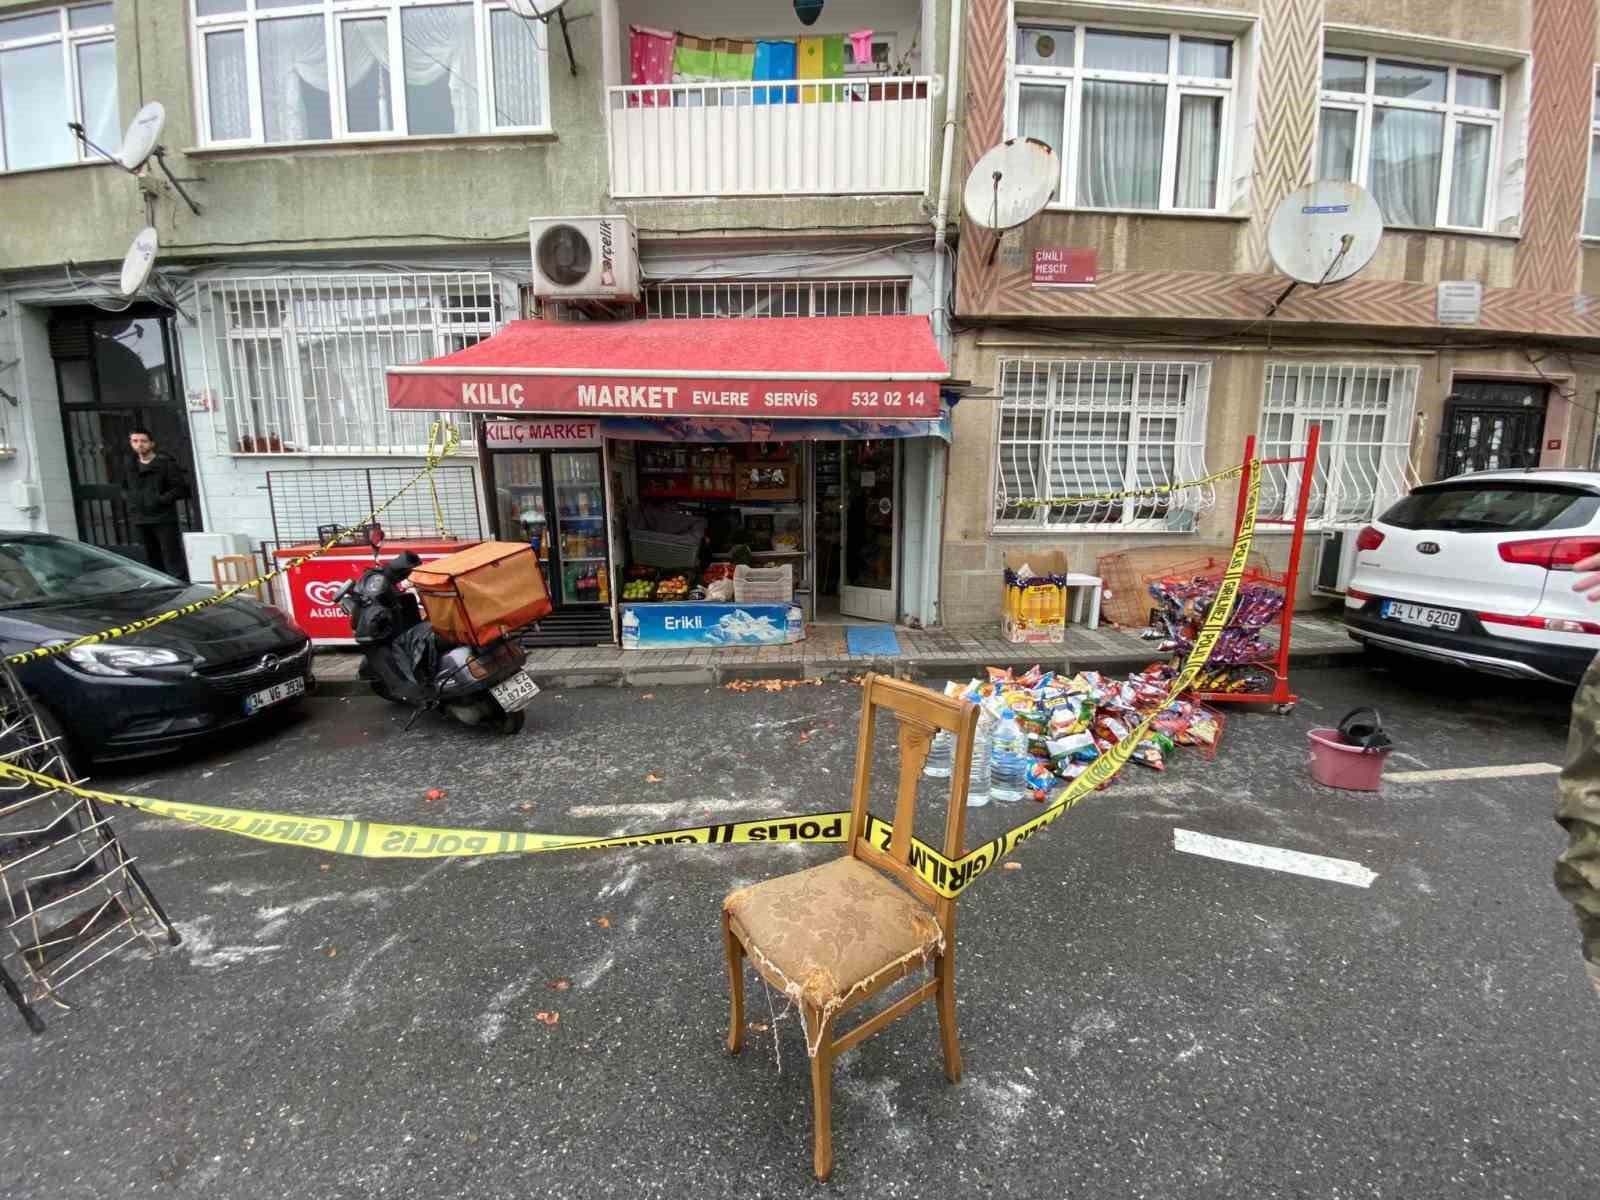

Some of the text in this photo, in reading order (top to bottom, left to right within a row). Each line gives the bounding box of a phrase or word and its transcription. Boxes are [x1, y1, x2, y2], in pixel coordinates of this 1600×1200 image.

[600, 219, 615, 271] arçelik
[462, 383, 924, 408] KILIÇ MARKET EVLERE SERVİS 532 02 14
[486, 423, 597, 443] KILIÇ MARKET
[1419, 544, 1437, 553] KIA
[1391, 603, 1403, 616] 34
[1408, 606, 1423, 620] LY
[664, 616, 702, 630] Erikli
[880, 827, 987, 892] GİRİLMZ
